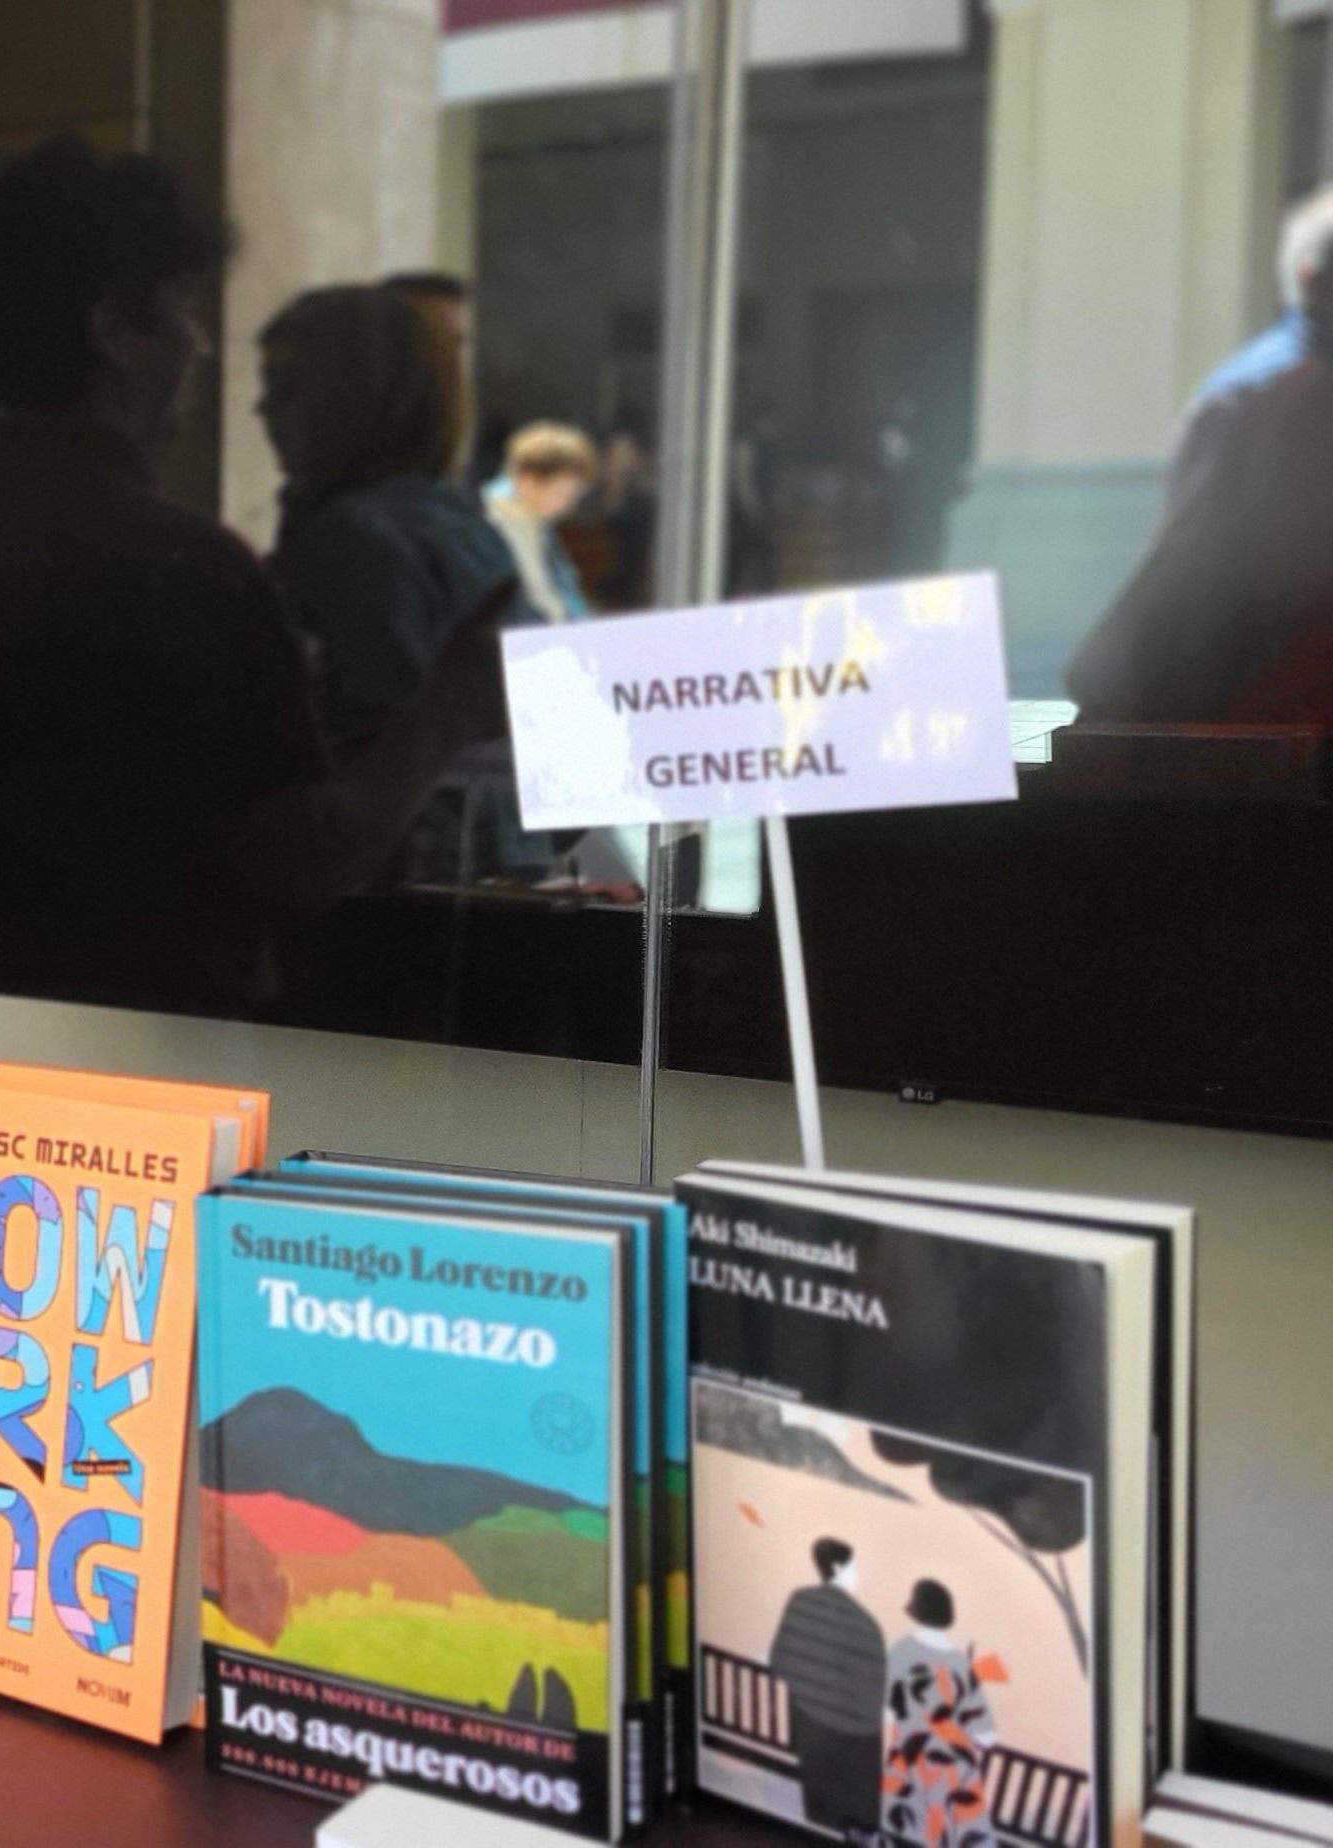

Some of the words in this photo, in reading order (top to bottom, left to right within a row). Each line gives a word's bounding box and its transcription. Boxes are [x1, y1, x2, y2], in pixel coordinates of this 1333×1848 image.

[612, 658, 872, 714] NARRATIVA
[644, 743, 847, 788] GENERAL
[917, 1089, 933, 1101] LG
[35, 1136, 179, 1184] MIRALLES
[231, 1222, 404, 1285] Santiago
[408, 1247, 589, 1304] Lorenzo
[689, 1212, 730, 1245] Aki
[734, 1219, 858, 1274] Shimazaki
[257, 1275, 557, 1369] Tostonazo
[689, 1256, 776, 1304] LUNA
[781, 1276, 889, 1331] LLENA
[217, 1659, 245, 1684] LA
[247, 1665, 317, 1703] NUEVA
[321, 1685, 408, 1724] NOVELA
[411, 1709, 455, 1734] DEL
[460, 1720, 540, 1755] AUTOR
[542, 1739, 577, 1763] DE
[219, 1685, 299, 1743] Los
[303, 1715, 583, 1816] asquerosos
